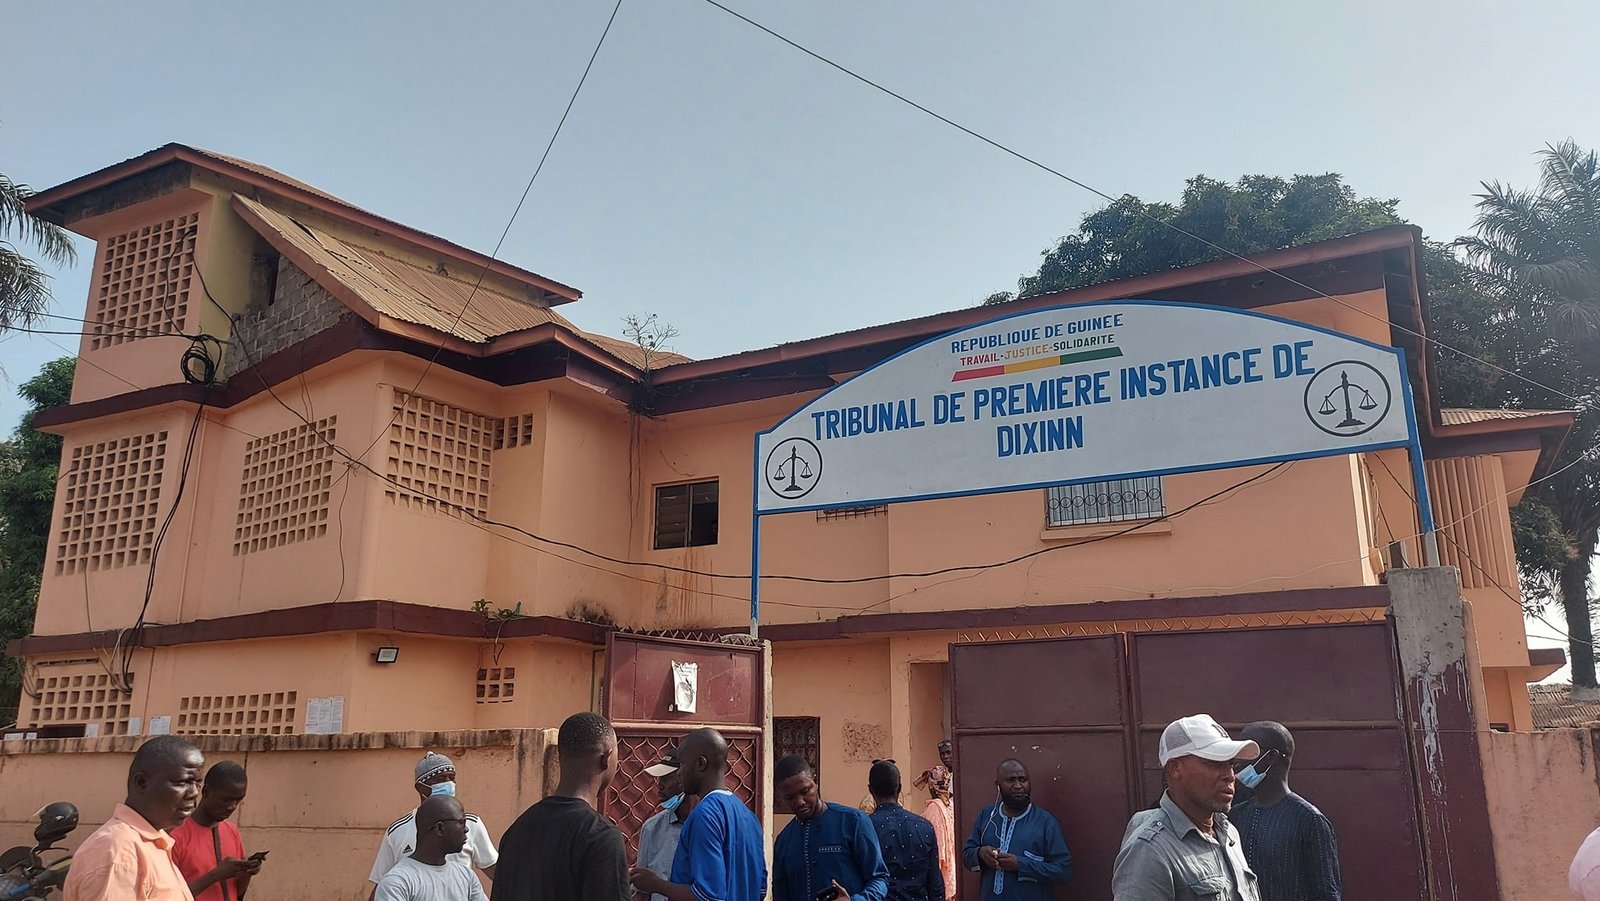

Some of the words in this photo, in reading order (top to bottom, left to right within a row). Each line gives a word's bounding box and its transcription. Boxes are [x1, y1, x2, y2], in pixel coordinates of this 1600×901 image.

[951, 327, 1040, 353] REPUBLIQUE
[1044, 323, 1063, 338] DE
[811, 398, 925, 440] TRIBUNAL
[933, 391, 966, 425] DE
[1120, 347, 1263, 400] INSTANCE
[1272, 340, 1316, 379] DE
[997, 415, 1084, 457] DIXINN
